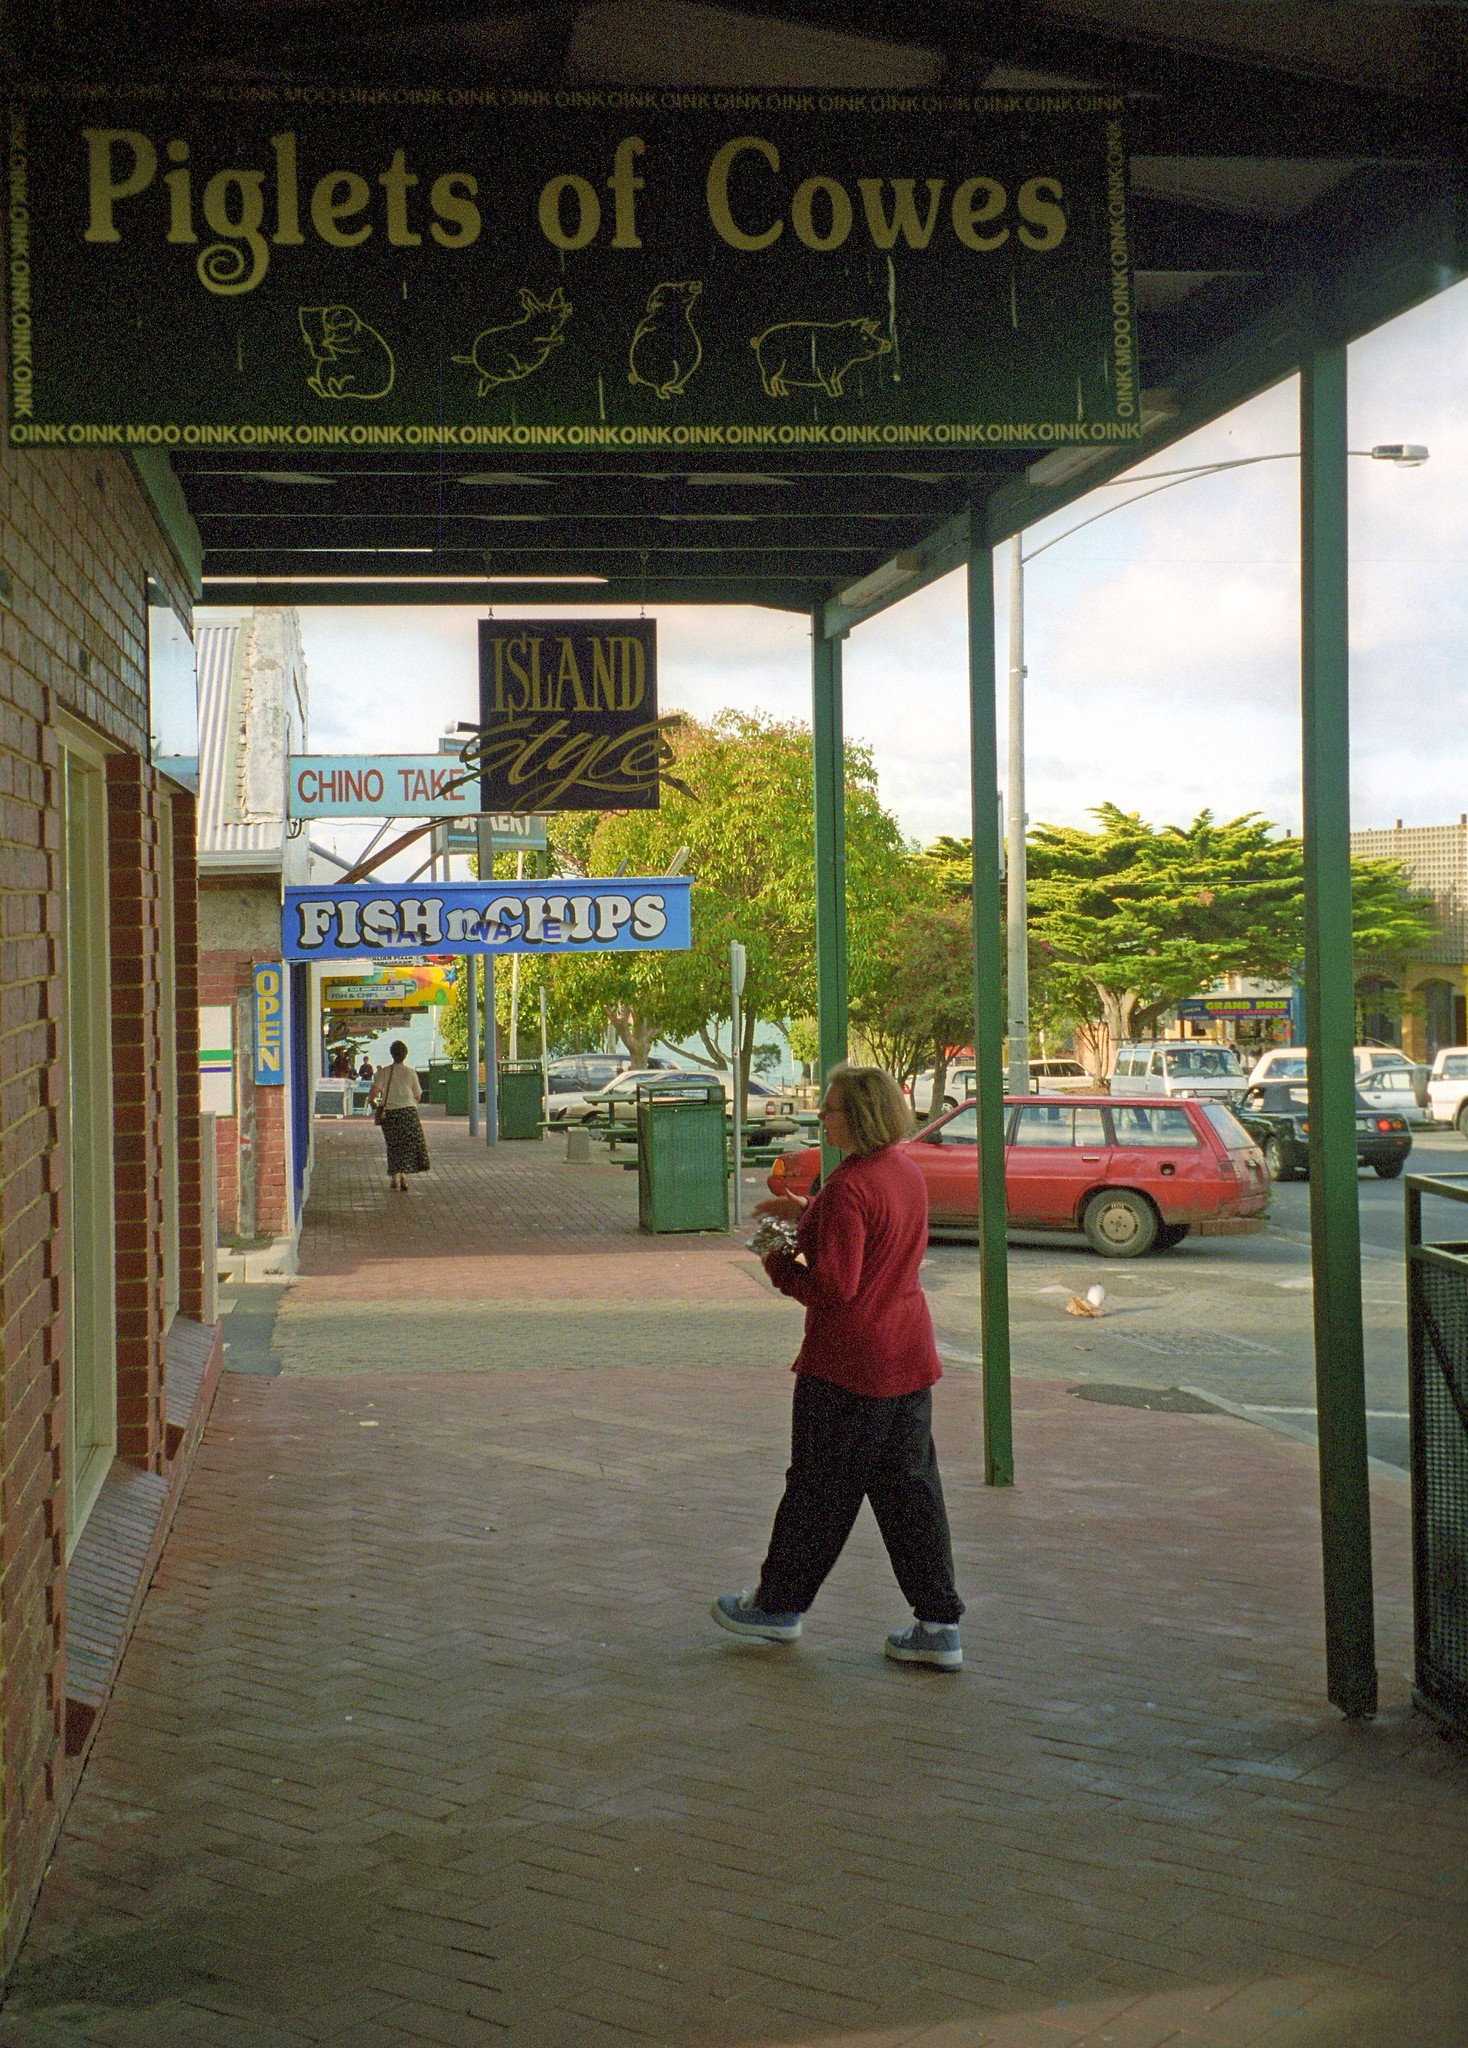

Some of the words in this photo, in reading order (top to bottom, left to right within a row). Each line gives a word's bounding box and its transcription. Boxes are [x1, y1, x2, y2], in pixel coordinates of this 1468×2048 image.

[82, 128, 482, 297] Piglets
[538, 135, 645, 251] of
[706, 135, 1069, 252] Cowes
[10, 424, 66, 443] OINK
[67, 424, 124, 443] OINK
[126, 425, 181, 444] MOO
[182, 425, 238, 444] OINK
[239, 425, 295, 444] OINK
[295, 425, 350, 444] OINK
[350, 425, 404, 444] OINK
[405, 425, 459, 444] OINK
[459, 425, 512, 444] OINK
[512, 425, 566, 444] OINK
[567, 425, 619, 444] OINK
[620, 425, 672, 444] OINK
[673, 425, 725, 444] OINK
[726, 425, 775, 444] OINK
[778, 425, 830, 444] OINK
[830, 424, 882, 443] OINK
[883, 424, 935, 443] OINK
[935, 424, 985, 442] OINK
[986, 423, 1037, 442] OINK
[1038, 422, 1088, 441] OINK
[1089, 422, 1139, 441] OINK
[491, 632, 646, 721] ISLAND
[297, 768, 384, 803] CHINO
[397, 768, 466, 802] TAKE
[296, 898, 444, 949] FISH
[482, 894, 667, 944] CHIPS
[256, 970, 281, 1072] OPEN
[1205, 1001, 1251, 1010] GRAND
[1255, 1001, 1288, 1009] PRIX
